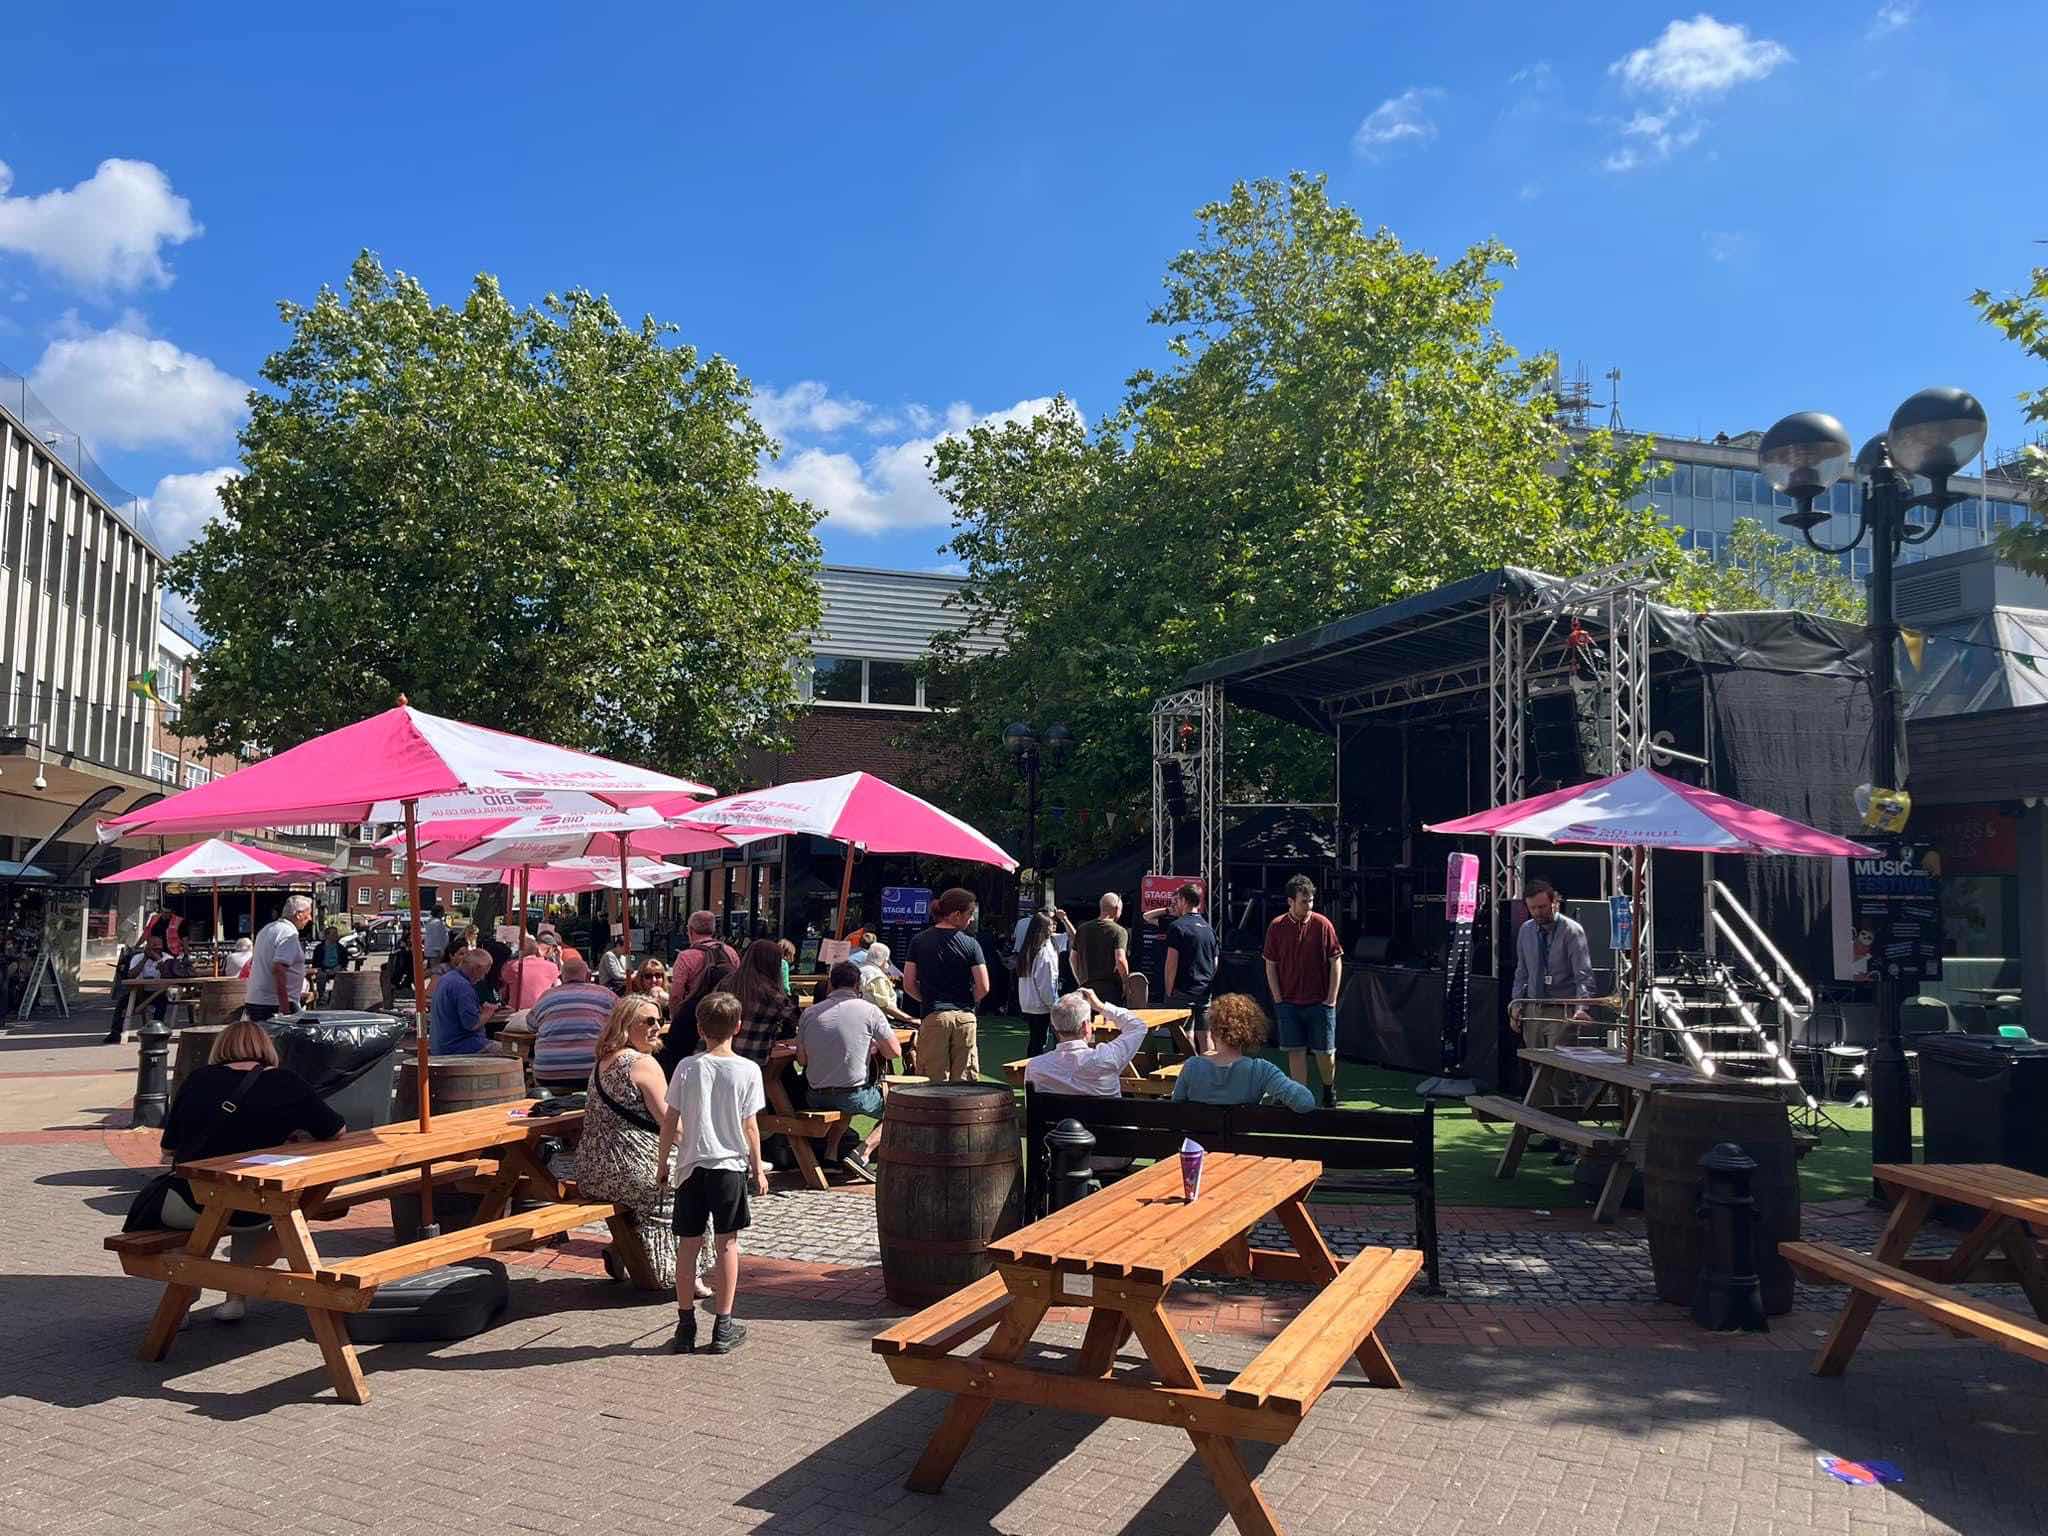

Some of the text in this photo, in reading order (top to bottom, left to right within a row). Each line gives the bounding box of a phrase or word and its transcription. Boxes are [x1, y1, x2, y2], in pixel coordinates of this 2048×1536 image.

[561, 815, 585, 824] BID
[1854, 860, 1914, 876] MUSIC
[1144, 891, 1173, 899] STAGE
[882, 906, 906, 914] STAGE
